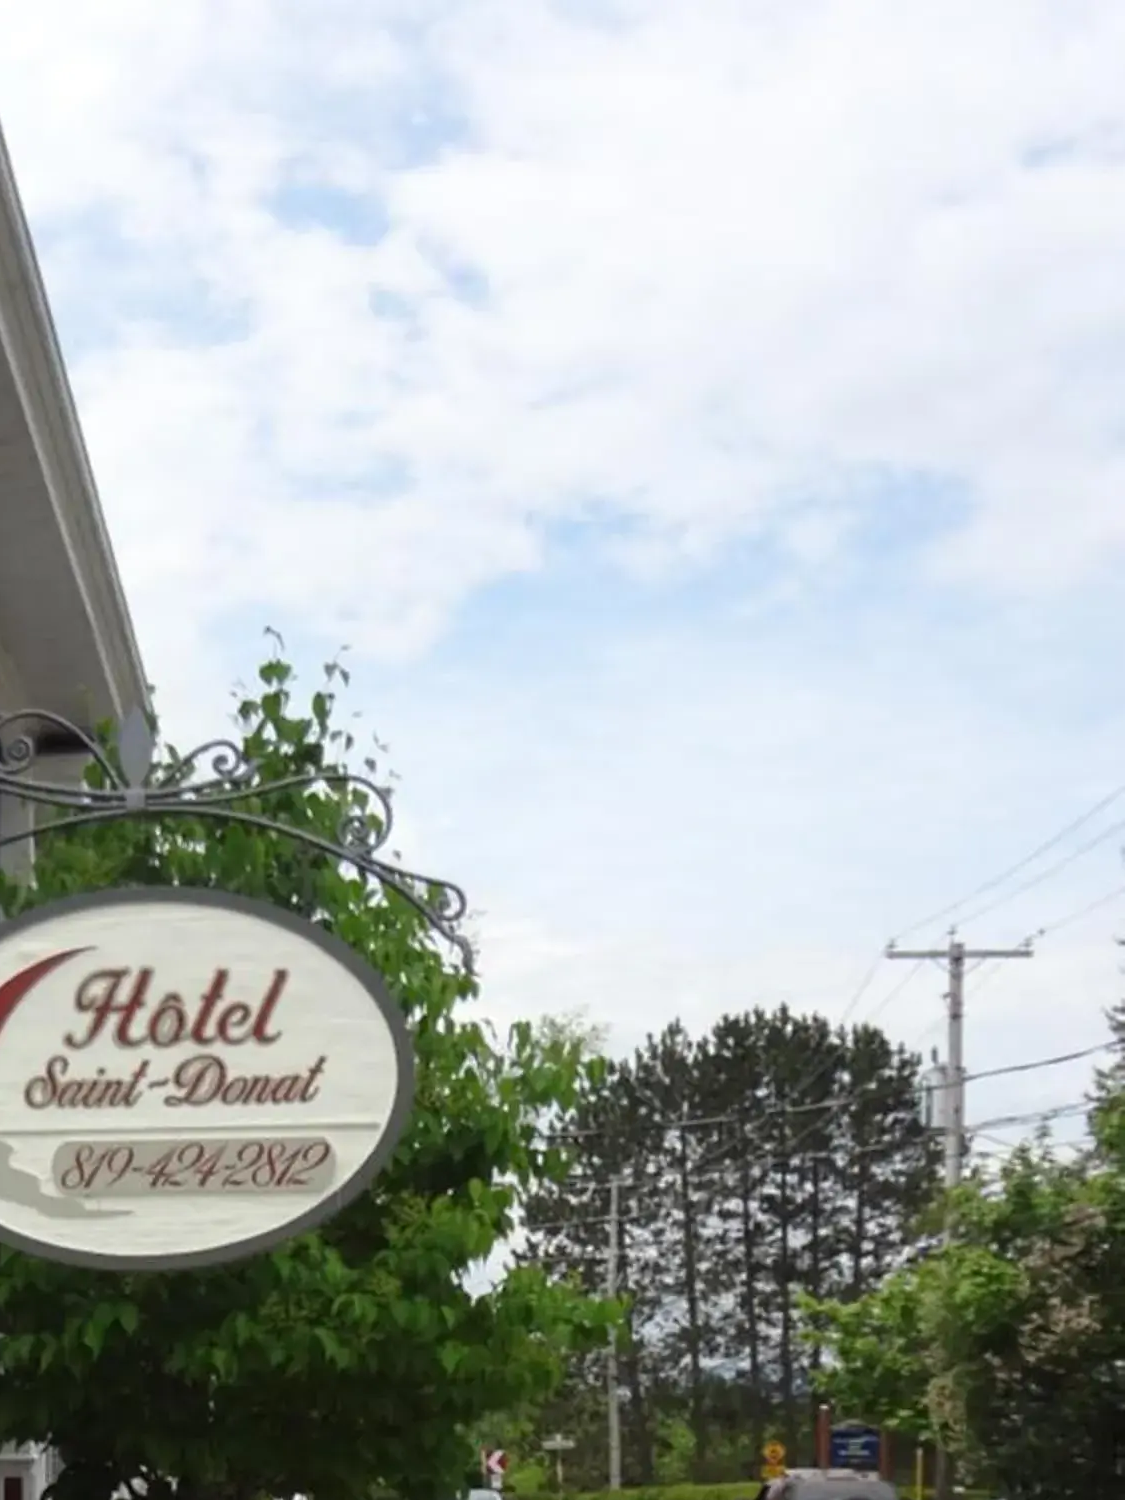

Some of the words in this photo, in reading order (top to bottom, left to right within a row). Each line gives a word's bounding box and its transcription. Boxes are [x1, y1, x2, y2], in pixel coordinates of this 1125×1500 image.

[64, 967, 289, 1049] Hôtel
[25, 1055, 327, 1109] Saint-Donat
[61, 1142, 331, 1190] 819-424-2812
